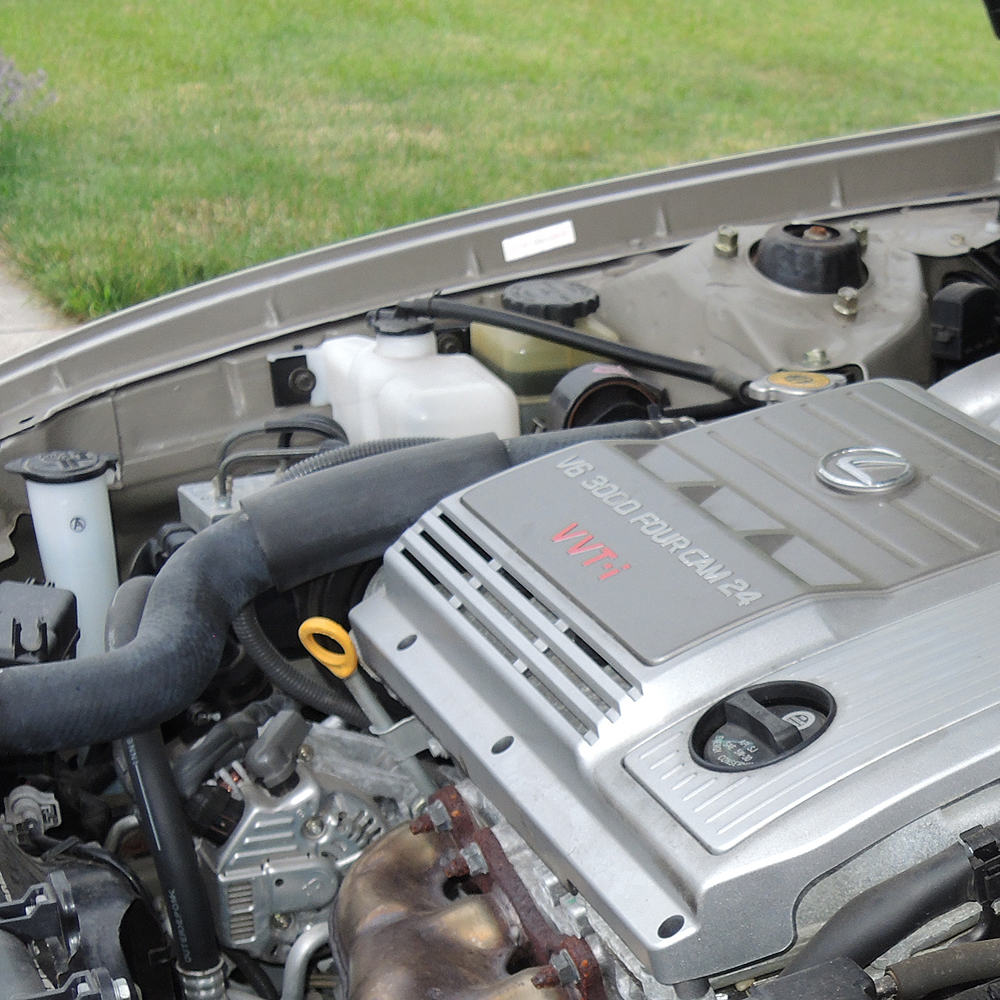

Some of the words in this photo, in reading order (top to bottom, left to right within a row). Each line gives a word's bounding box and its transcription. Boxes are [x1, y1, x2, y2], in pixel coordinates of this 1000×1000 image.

[556, 454, 594, 477] V6
[582, 473, 644, 515] 3000
[630, 511, 691, 554] FOUR
[678, 547, 734, 584] CAM
[717, 575, 764, 607] 24
